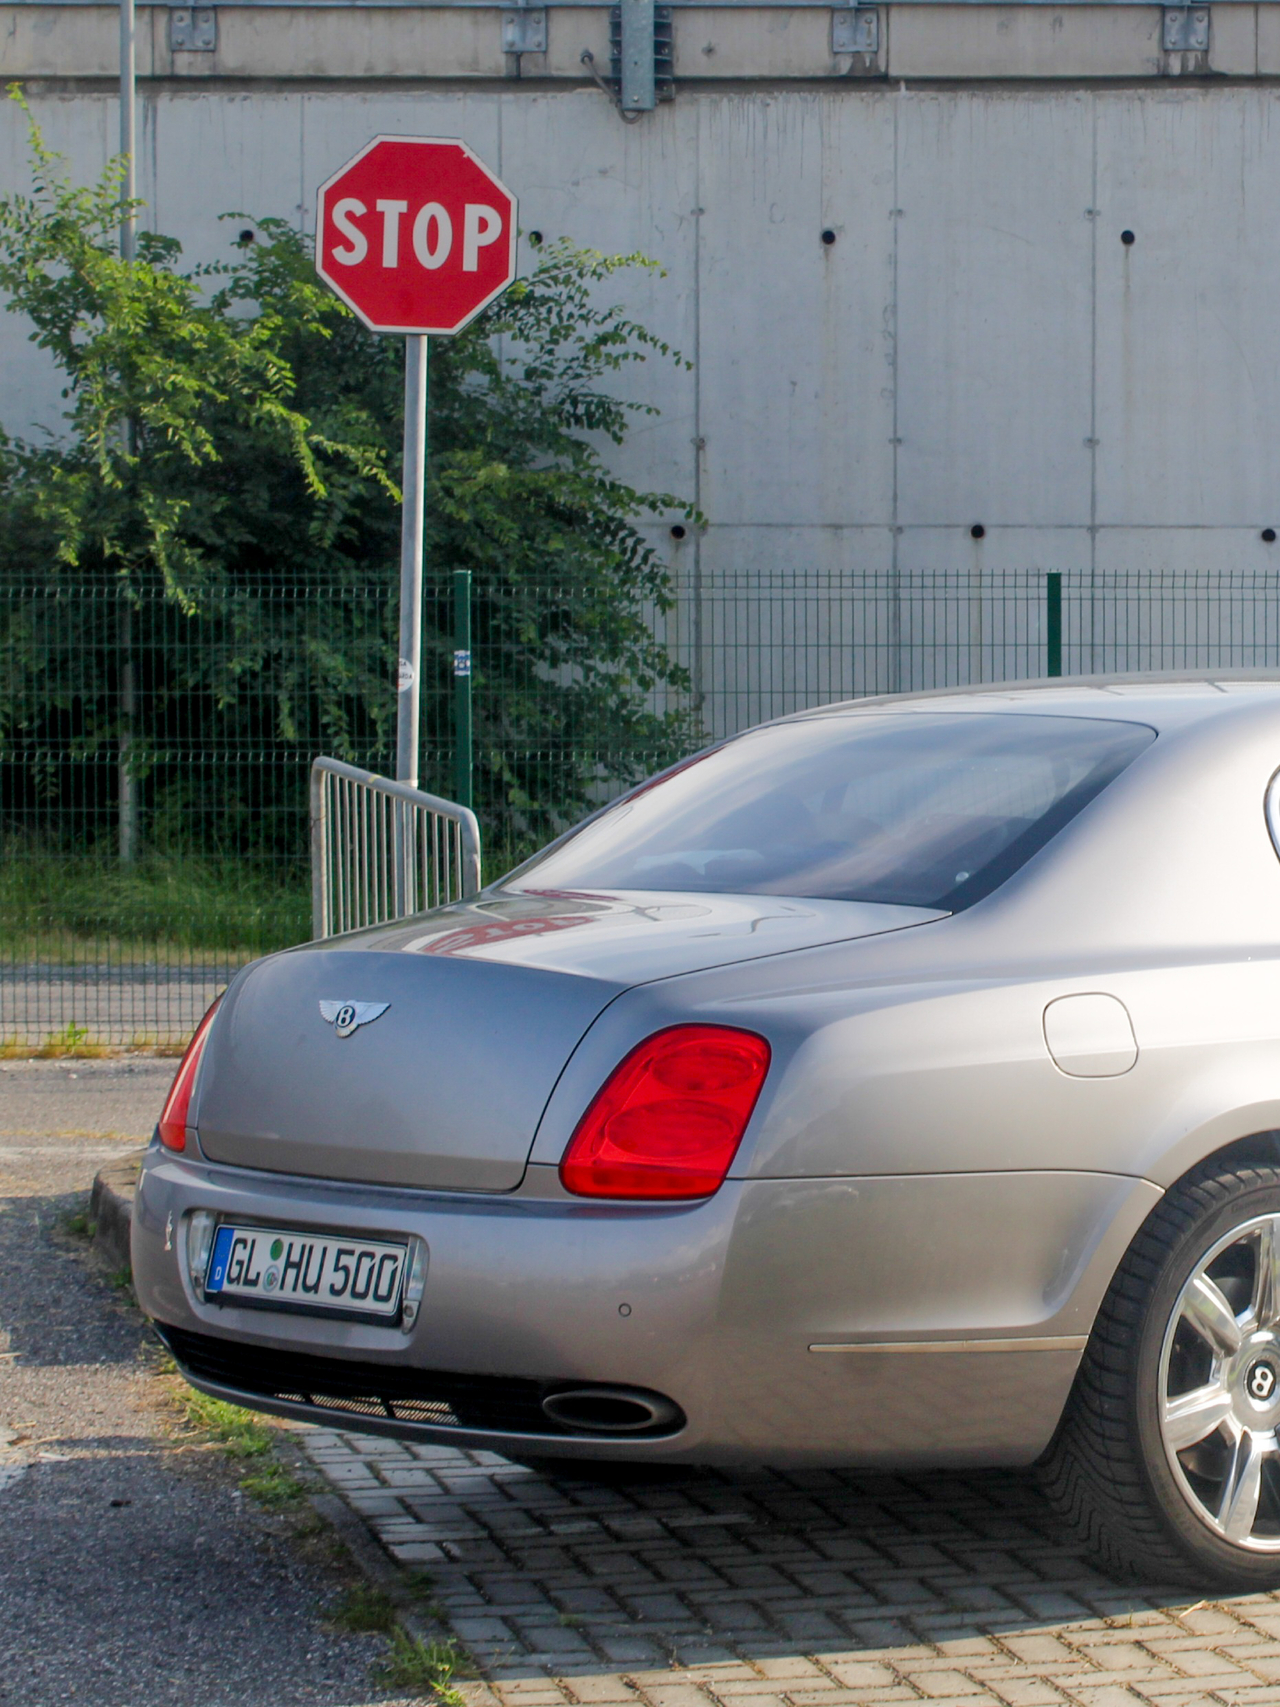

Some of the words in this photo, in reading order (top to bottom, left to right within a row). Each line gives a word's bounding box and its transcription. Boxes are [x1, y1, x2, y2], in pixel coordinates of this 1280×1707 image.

[332, 197, 503, 273] STOP
[213, 1266, 222, 1281] D
[226, 1237, 260, 1287] GL
[279, 1242, 328, 1295] HU
[329, 1248, 399, 1303] 500
[1251, 1366, 1274, 1397] B
